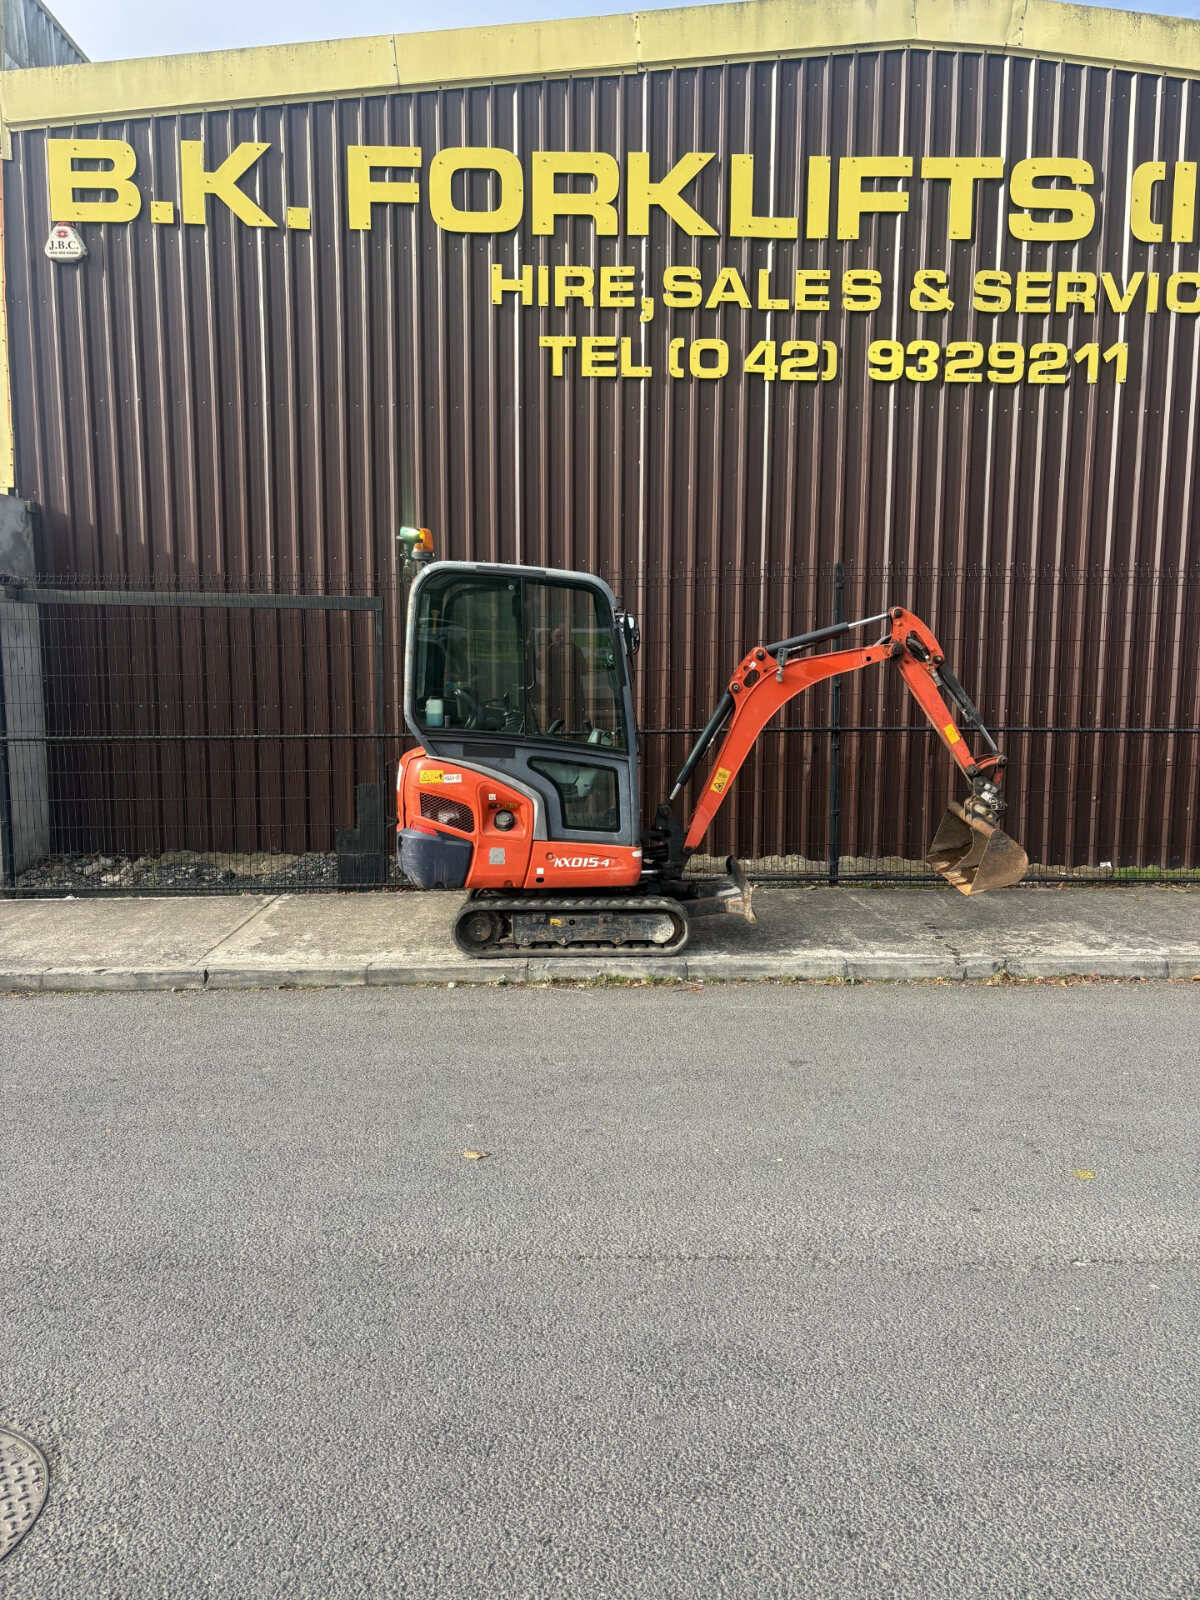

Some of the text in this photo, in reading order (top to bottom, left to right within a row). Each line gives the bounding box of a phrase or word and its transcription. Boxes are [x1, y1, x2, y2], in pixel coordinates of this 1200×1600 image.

[48, 139, 311, 230] B.K.
[346, 145, 1096, 242] FORKLIFTS
[49, 240, 79, 250] J.B.C.
[909, 268, 955, 313] &
[538, 336, 653, 378] TEL
[867, 340, 1129, 385] 9329211
[554, 857, 610, 868] KX015-4
